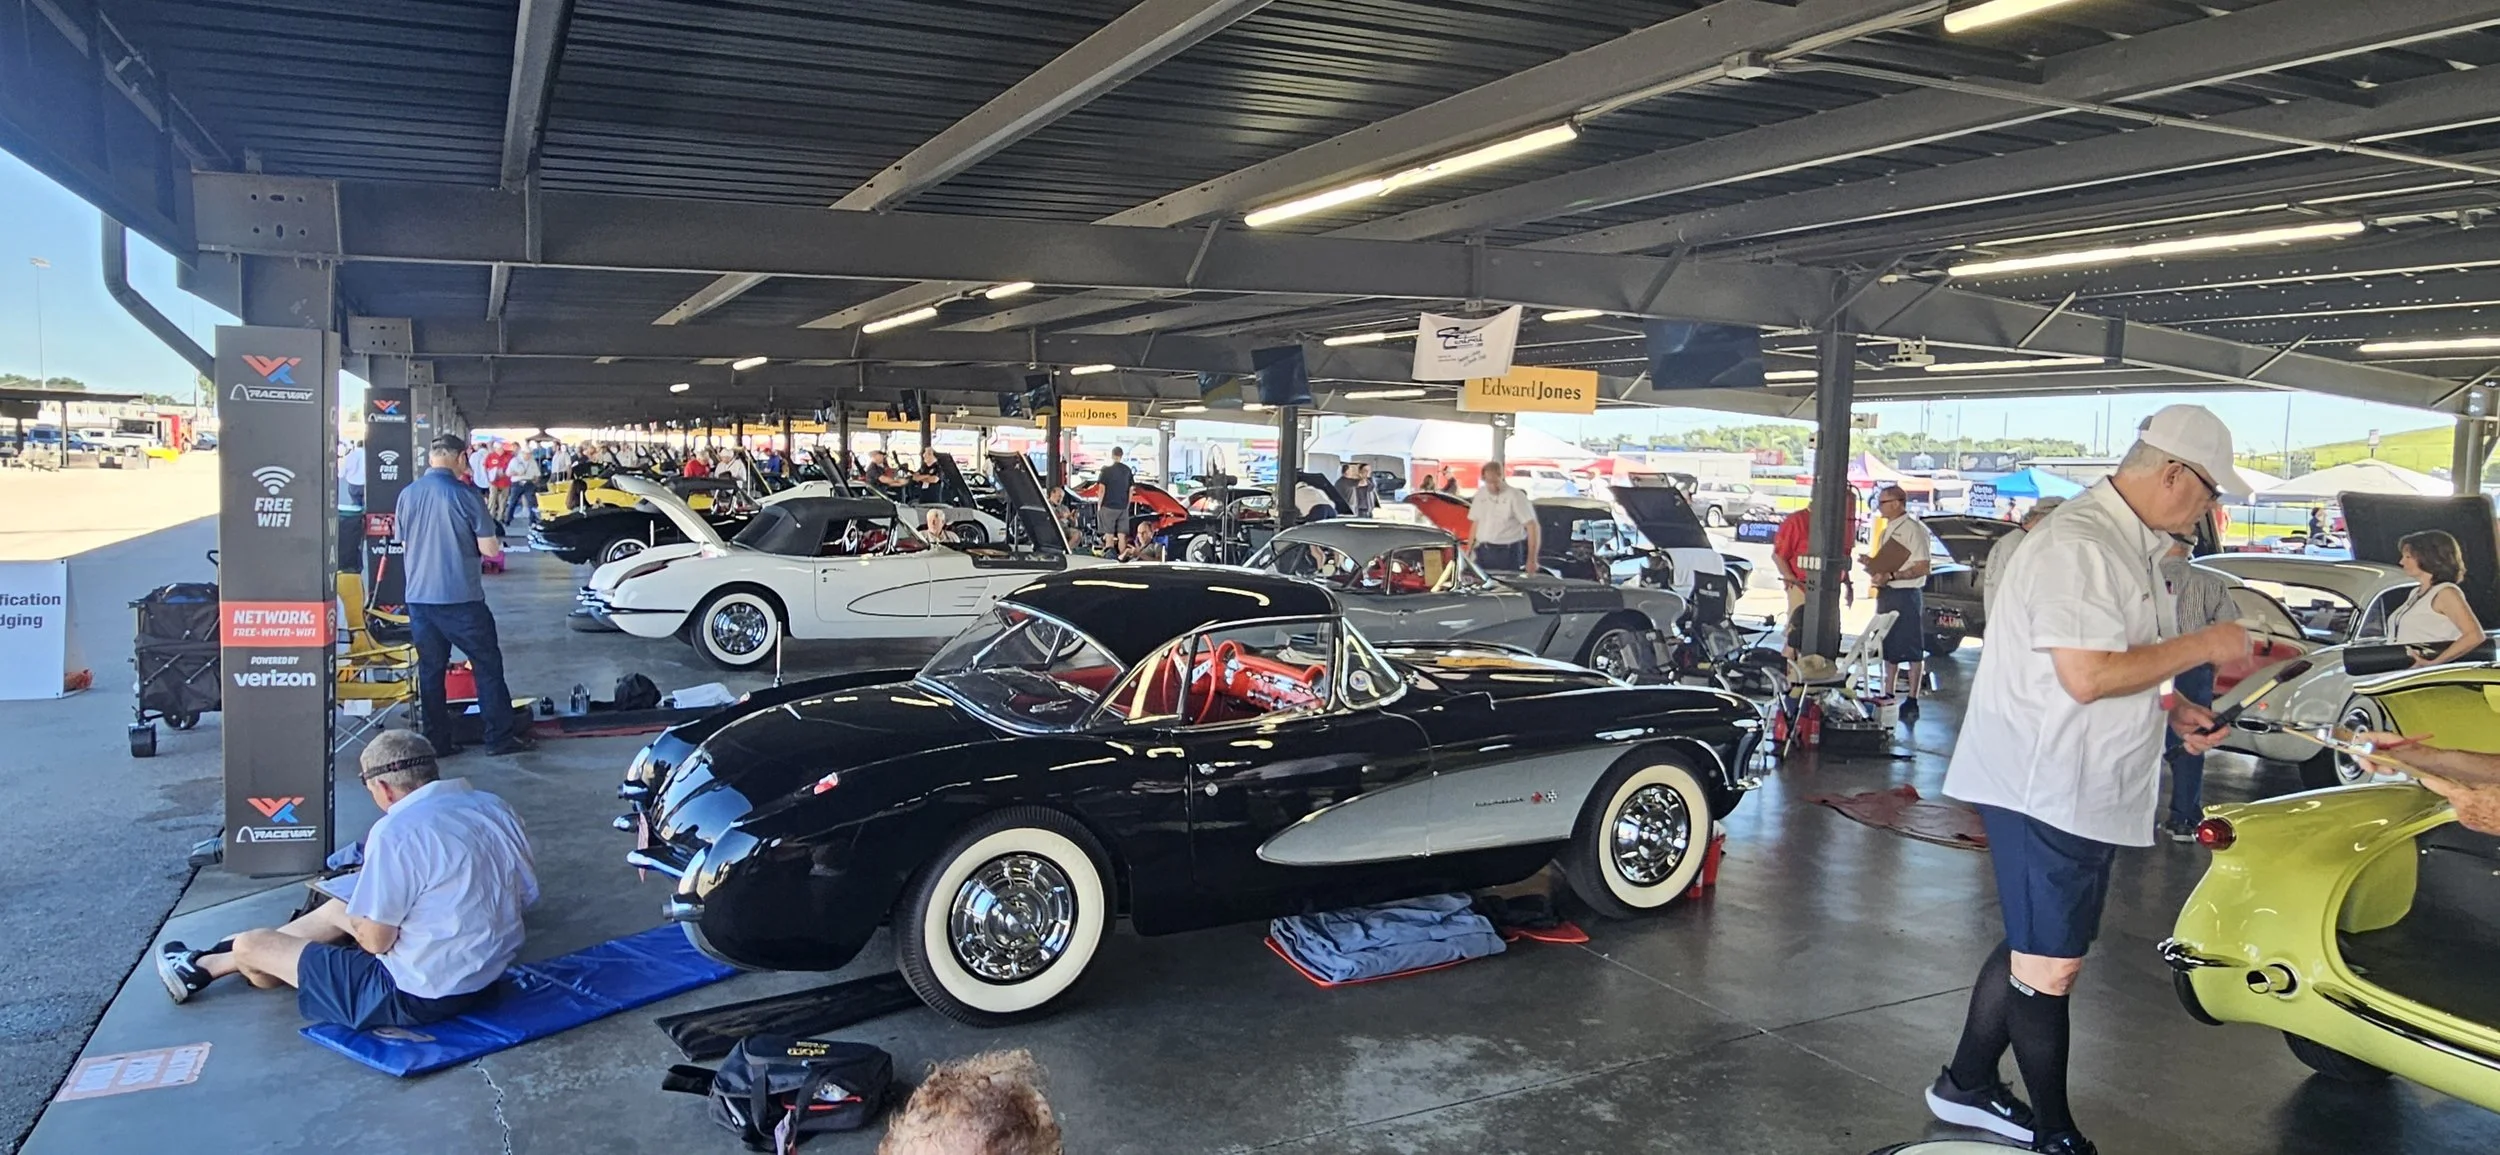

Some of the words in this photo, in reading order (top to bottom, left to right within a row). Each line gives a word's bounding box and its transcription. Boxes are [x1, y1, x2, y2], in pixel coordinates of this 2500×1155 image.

[249, 389, 314, 400] RACEWAY
[1481, 377, 1536, 397] Edward
[1537, 381, 1581, 400] Jones
[1062, 408, 1086, 418] ward
[1087, 408, 1117, 420] Jones
[254, 497, 293, 512] FREE
[327, 406, 337, 591] GATEWAY
[257, 513, 292, 528] WIFI
[371, 545, 404, 554] veizo
[233, 610, 316, 624] NETWORK:
[250, 656, 286, 665] POWERED
[287, 656, 299, 665] BY
[233, 669, 316, 687] verizon
[254, 829, 316, 840] RACEWAY
